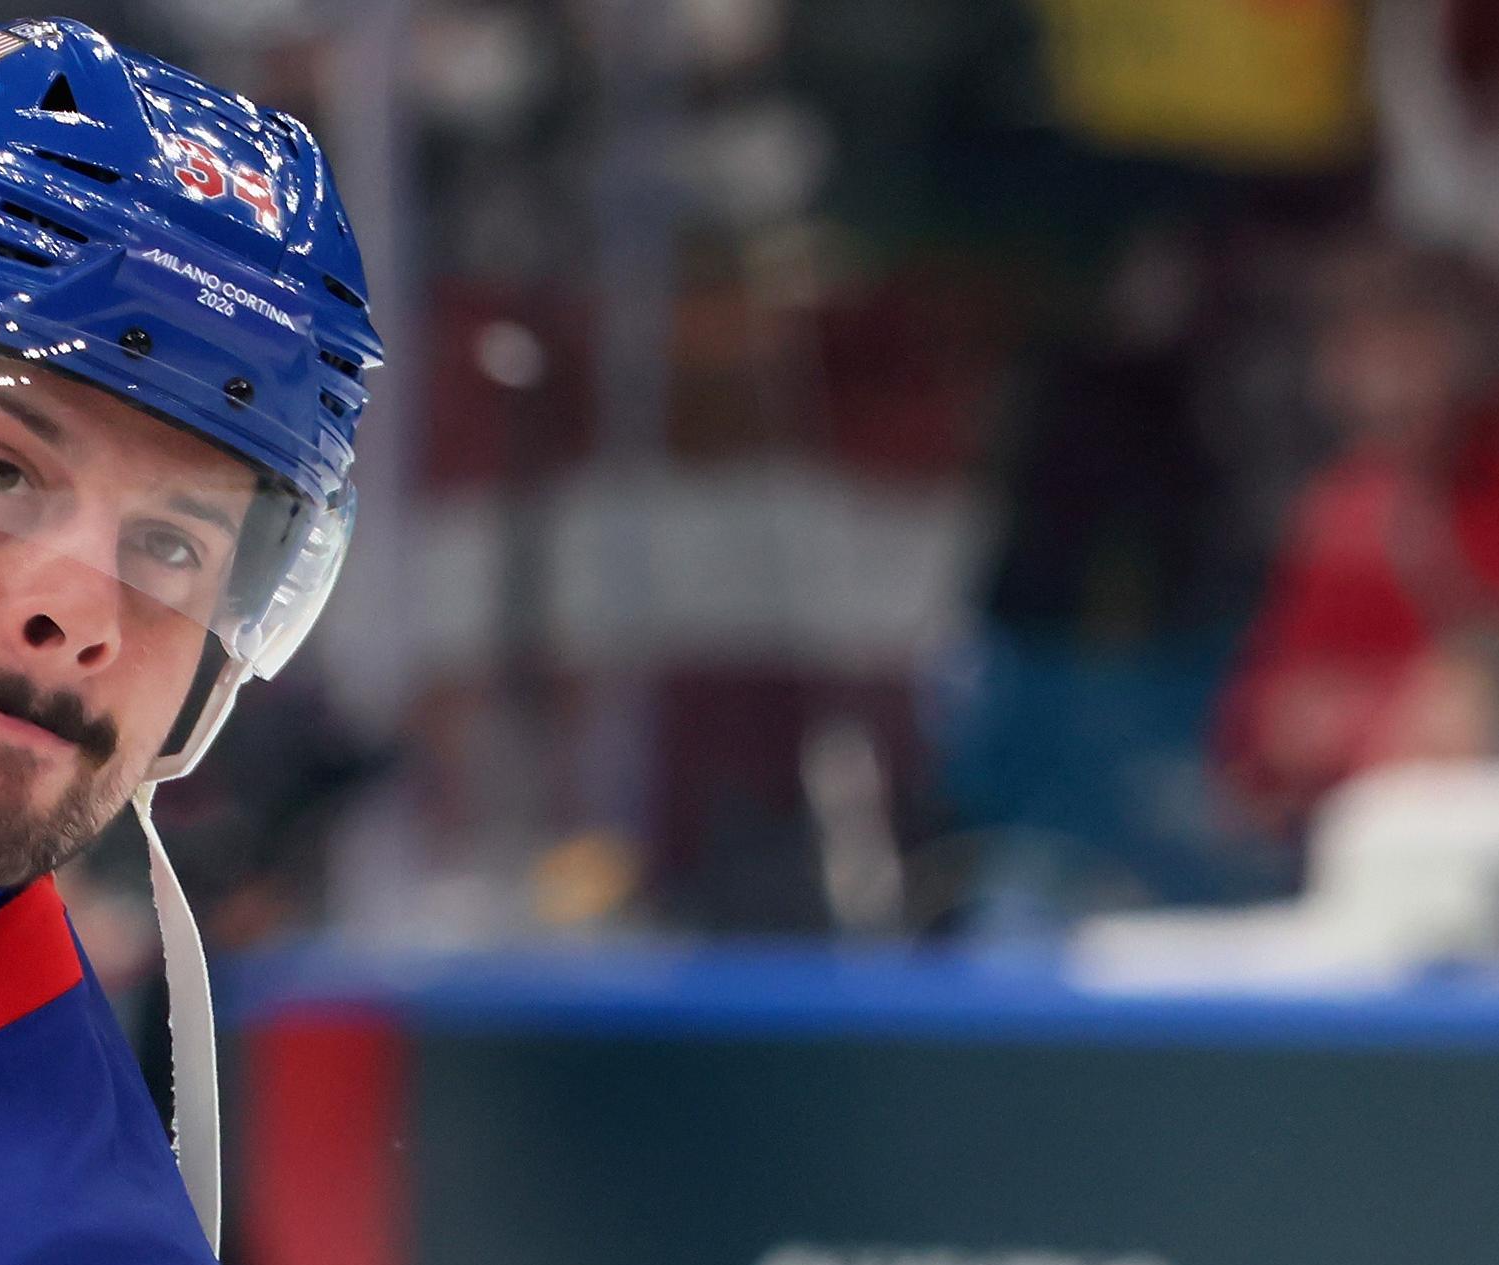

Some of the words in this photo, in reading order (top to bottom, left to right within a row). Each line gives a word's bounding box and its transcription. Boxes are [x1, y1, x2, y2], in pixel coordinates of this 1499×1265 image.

[173, 137, 281, 236] 34
[142, 248, 221, 290] MILANO
[222, 282, 297, 332] CORTINA
[196, 287, 237, 319] 2026
